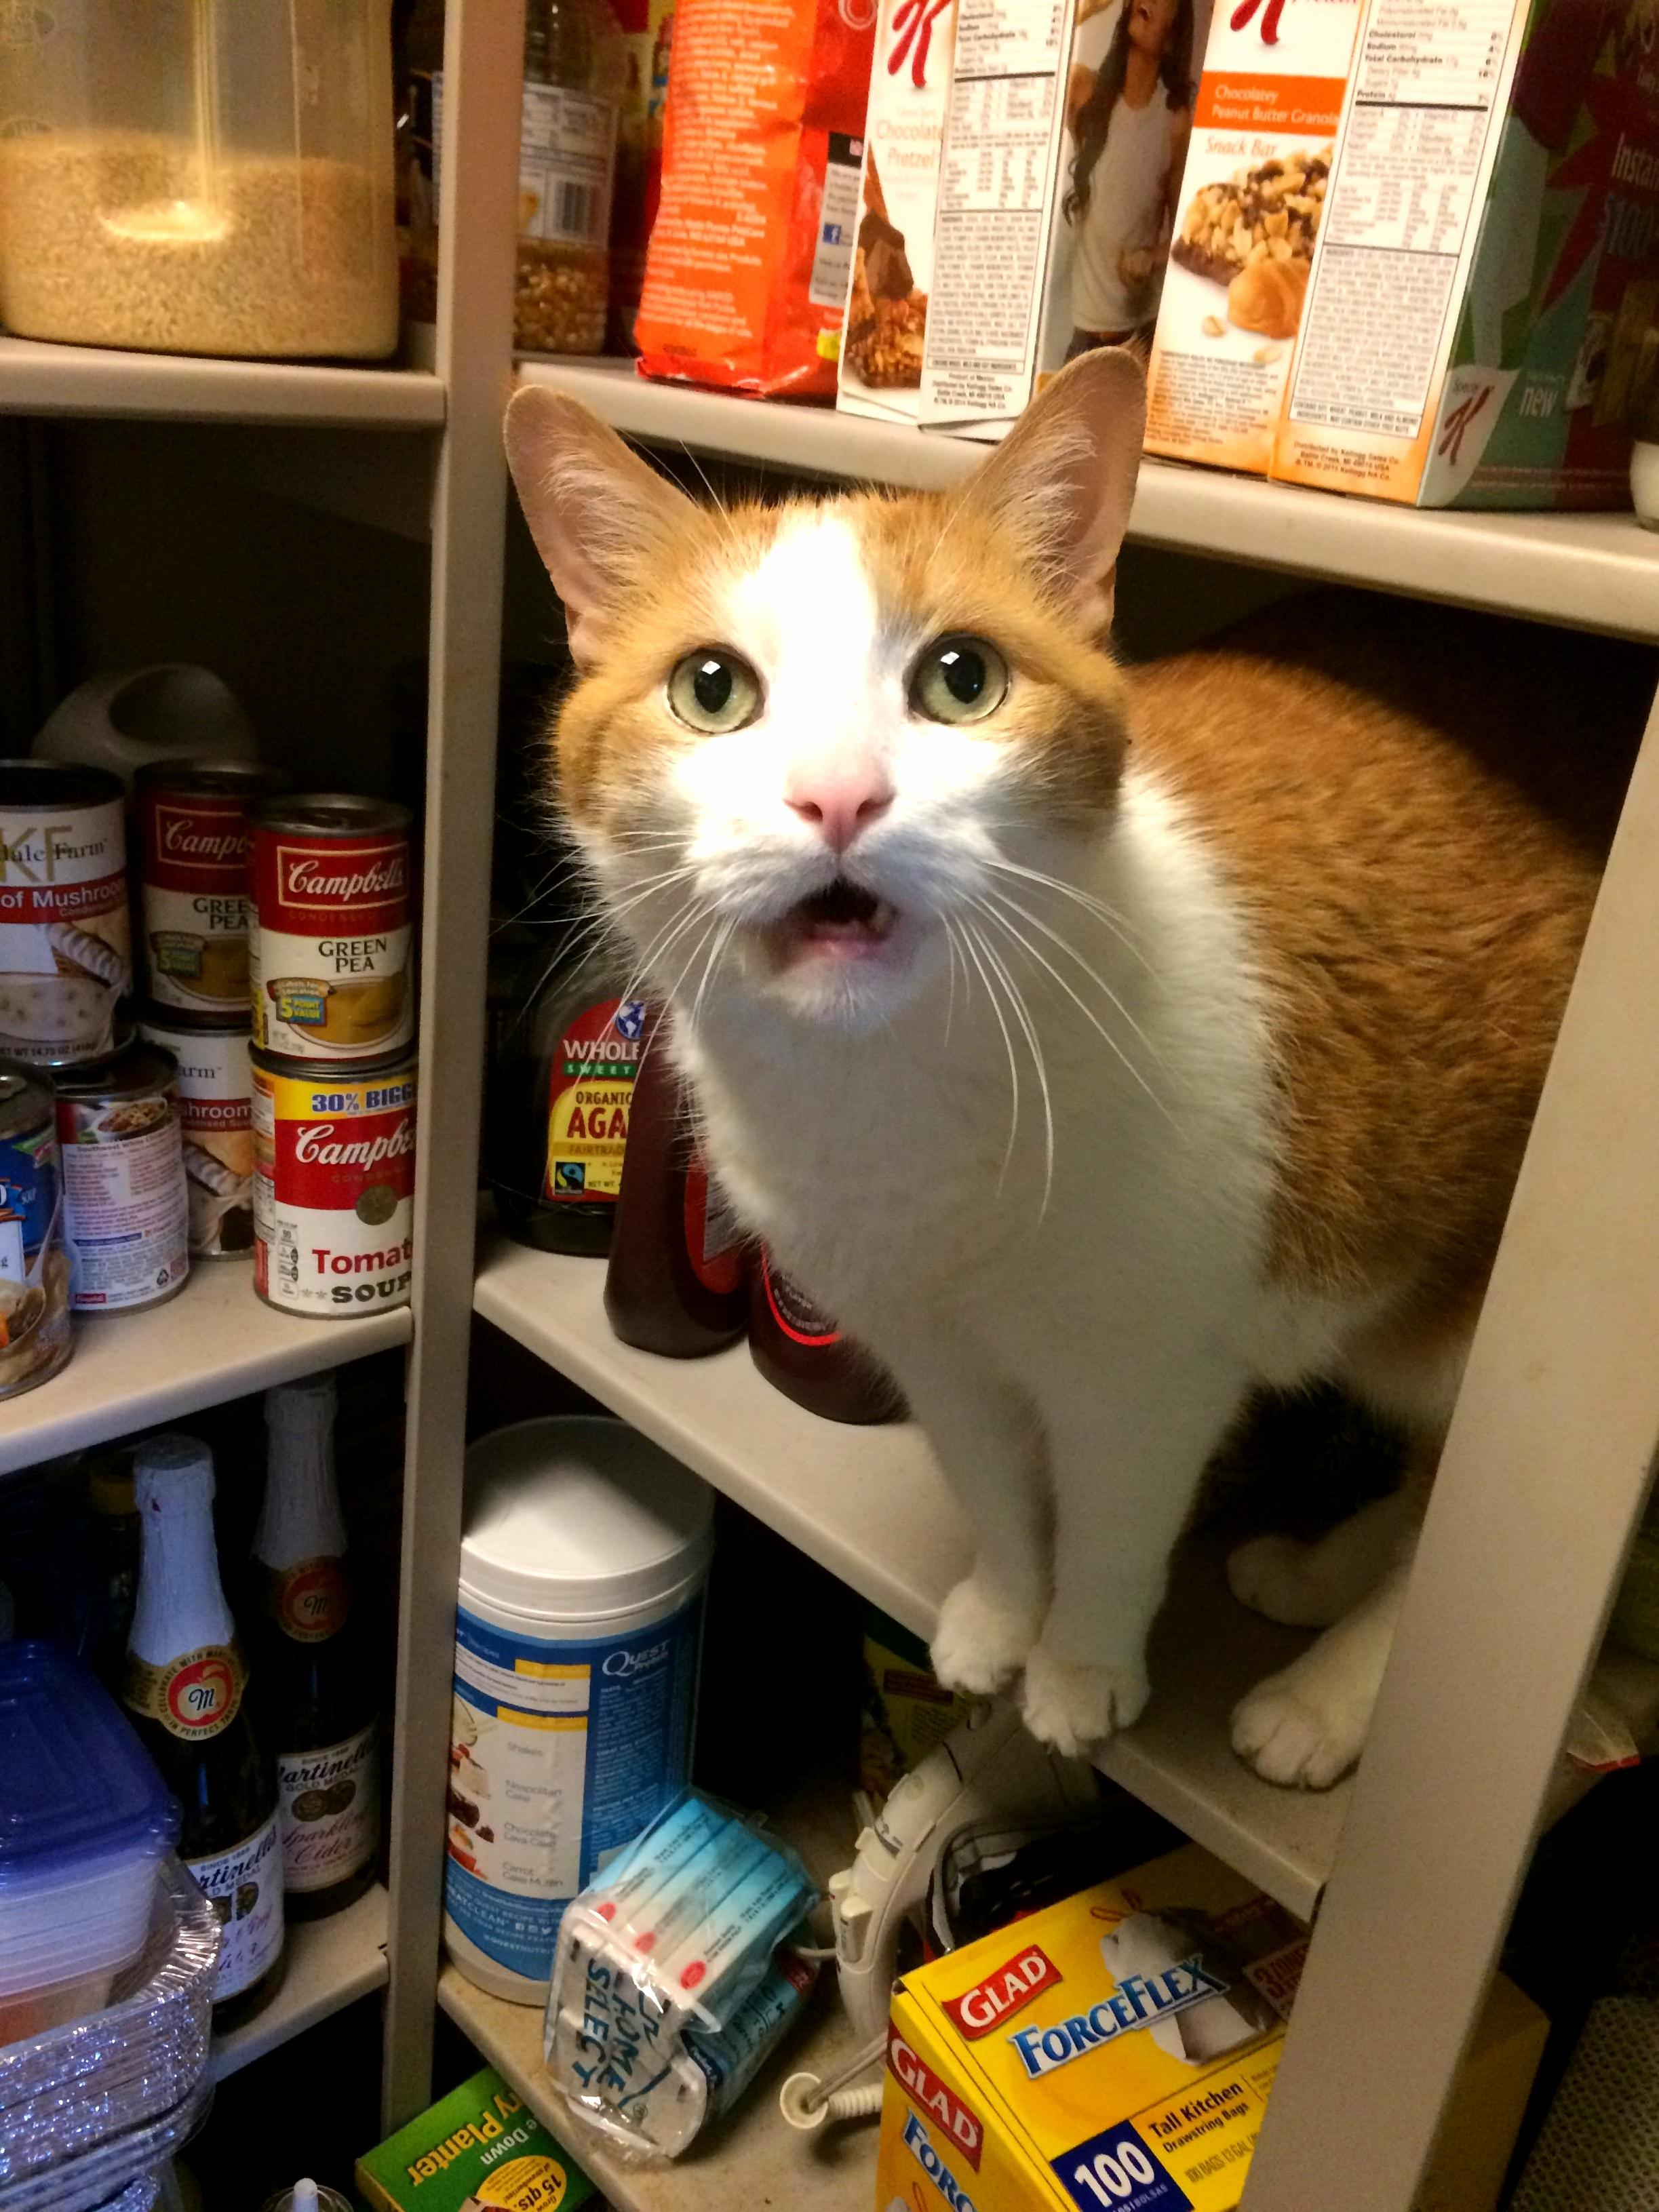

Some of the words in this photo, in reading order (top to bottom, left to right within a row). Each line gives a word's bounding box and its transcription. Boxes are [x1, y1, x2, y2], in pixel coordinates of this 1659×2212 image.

[1369, 29, 1416, 39] Cholesterol
[1367, 42, 1397, 50] Sodium
[1365, 54, 1384, 63] Total
[1386, 54, 1443, 66] Carbohydrate
[1215, 83, 1280, 105] Chocolatey
[1357, 89, 1386, 98] Protein
[1212, 104, 1251, 120] Peanut
[1252, 106, 1289, 123] Butter
[1205, 135, 1246, 156] Snack
[1251, 138, 1277, 157] Bar
[1293, 440, 1329, 453] Distributed
[1340, 448, 1366, 462] Kellogg
[1368, 452, 1387, 462] Sales
[1300, 450, 1319, 460] Battle
[1374, 462, 1390, 471] USA
[1340, 466, 1366, 479] Kellogg
[1, 891, 24, 909] of
[209, 915, 250, 930] PEA
[318, 938, 387, 958] GREEN
[335, 955, 375, 973] PEA
[281, 998, 294, 1018] 5
[293, 1009, 321, 1019] VALUE
[311, 1092, 360, 1113] 30%
[602, 1640, 670, 1678] QUEST
[188, 1688, 216, 1712] M
[960, 1954, 1047, 2028] GLAD
[891, 2038, 977, 2150] GLAD
[1148, 2111, 1184, 2140] Tall
[1179, 2081, 1244, 2123] Kitchen
[1161, 2113, 1226, 2154] Drawstring
[1220, 2101, 1250, 2121] Bags
[407, 2110, 505, 2188] Planter
[480, 2127, 530, 2166] Down
[542, 2173, 562, 2196] 15
[1074, 2141, 1155, 2208] 100
[513, 2186, 543, 2212] qts.
